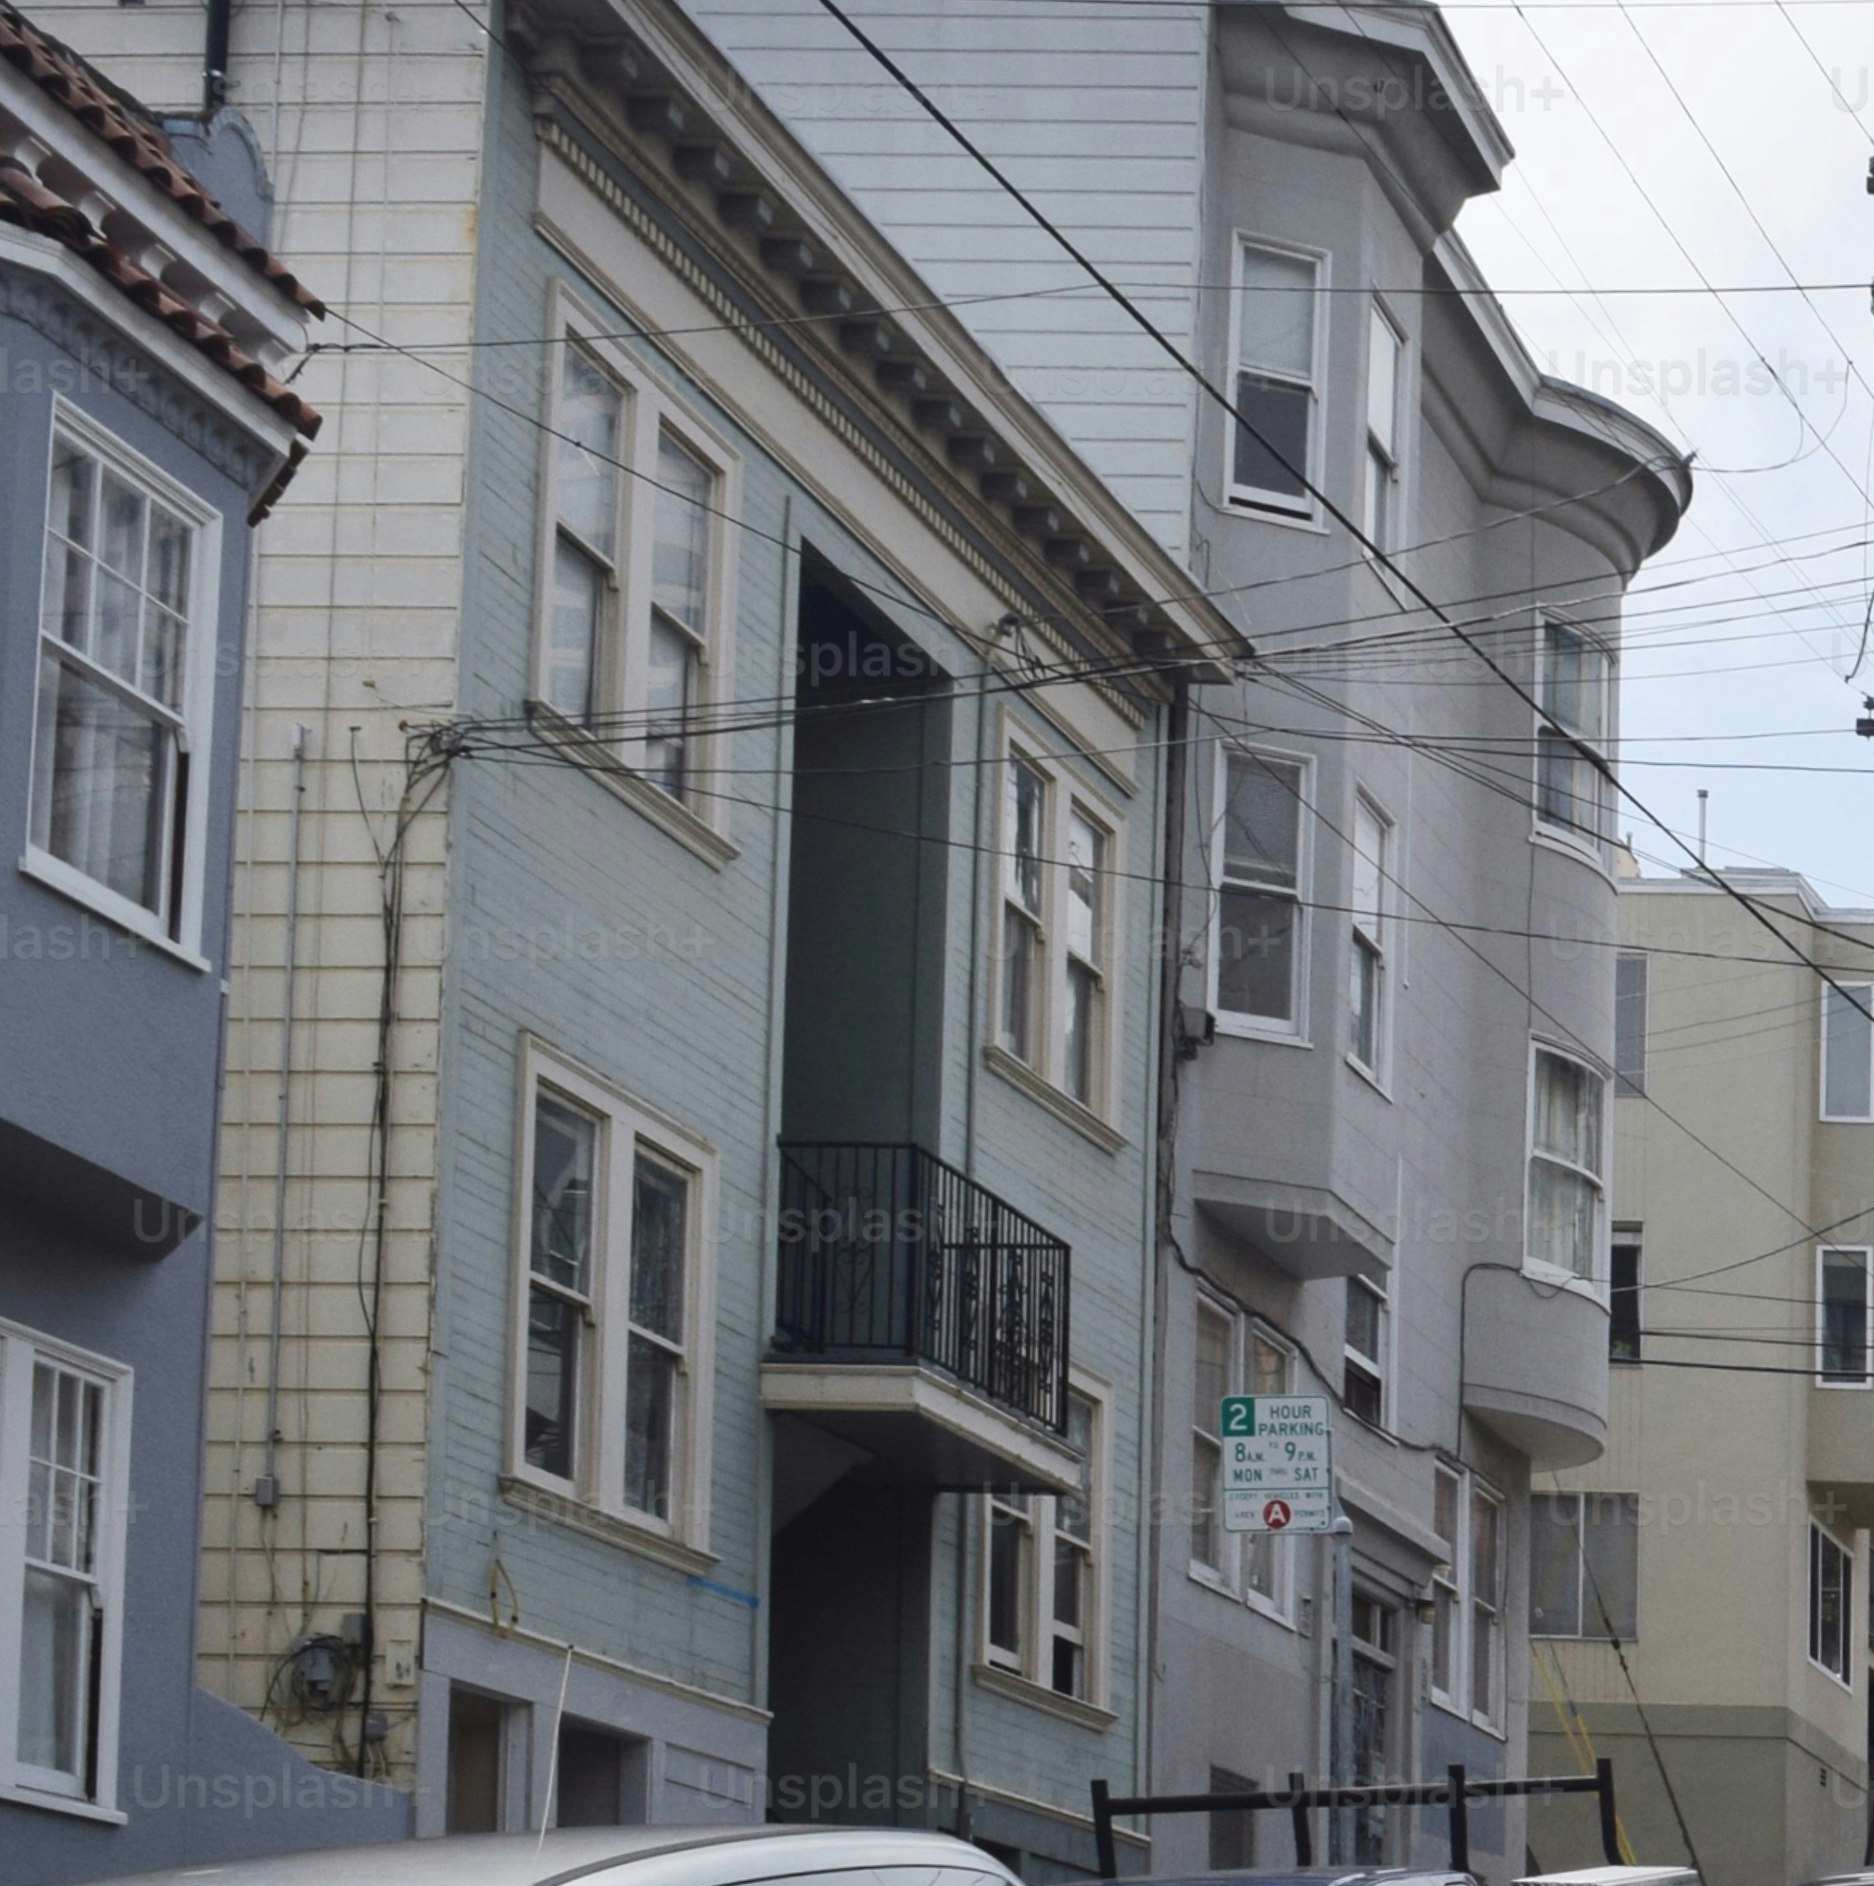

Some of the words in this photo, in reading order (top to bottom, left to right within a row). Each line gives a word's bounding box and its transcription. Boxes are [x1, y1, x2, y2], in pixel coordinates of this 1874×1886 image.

[1229, 1403, 1247, 1430] 2
[1269, 1405, 1312, 1419] HOUR
[1258, 1422, 1324, 1436] PARKING
[1233, 1468, 1262, 1482] MON
[1294, 1467, 1318, 1482] SAT
[1268, 1502, 1286, 1523] A
